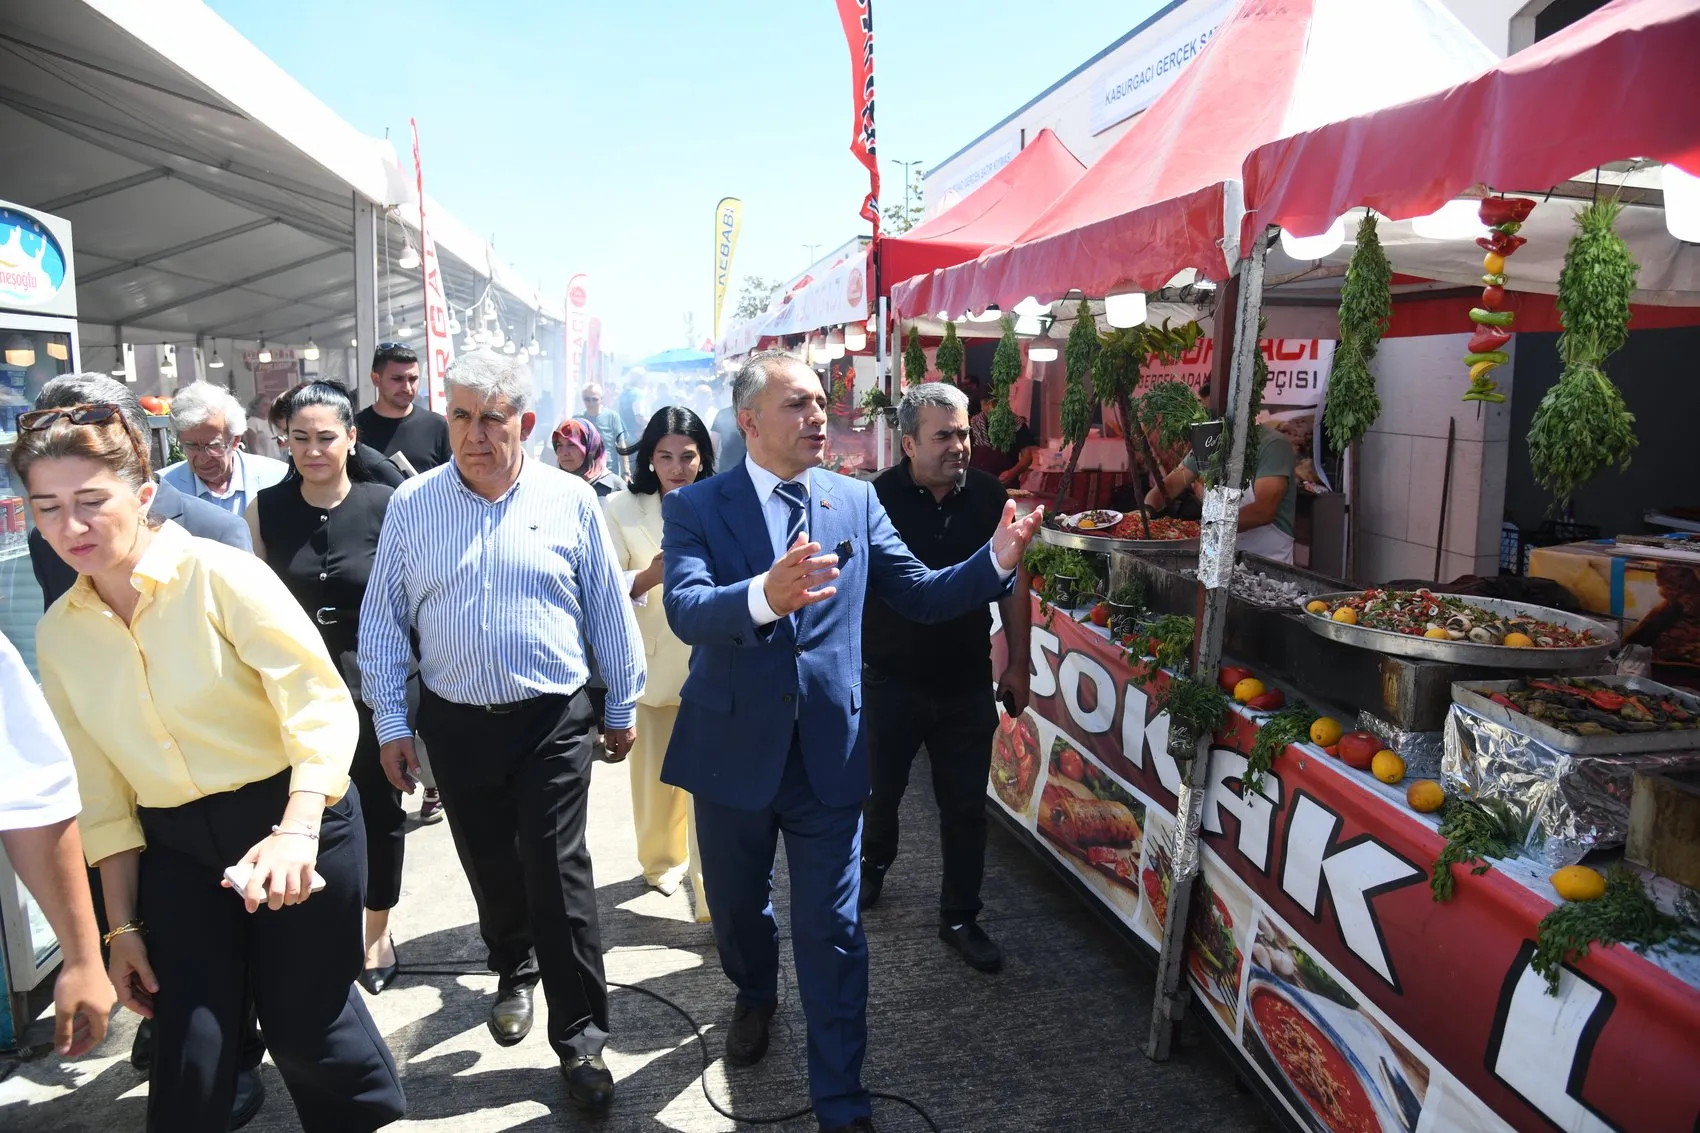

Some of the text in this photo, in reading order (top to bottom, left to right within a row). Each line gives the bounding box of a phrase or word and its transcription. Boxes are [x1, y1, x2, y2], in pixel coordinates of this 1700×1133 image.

[1105, 67, 1154, 106] KABURGACI
[1156, 38, 1198, 77] GERÇEK
[1264, 370, 1318, 396] PÇISI
[1029, 623, 1426, 993] SOKAK
